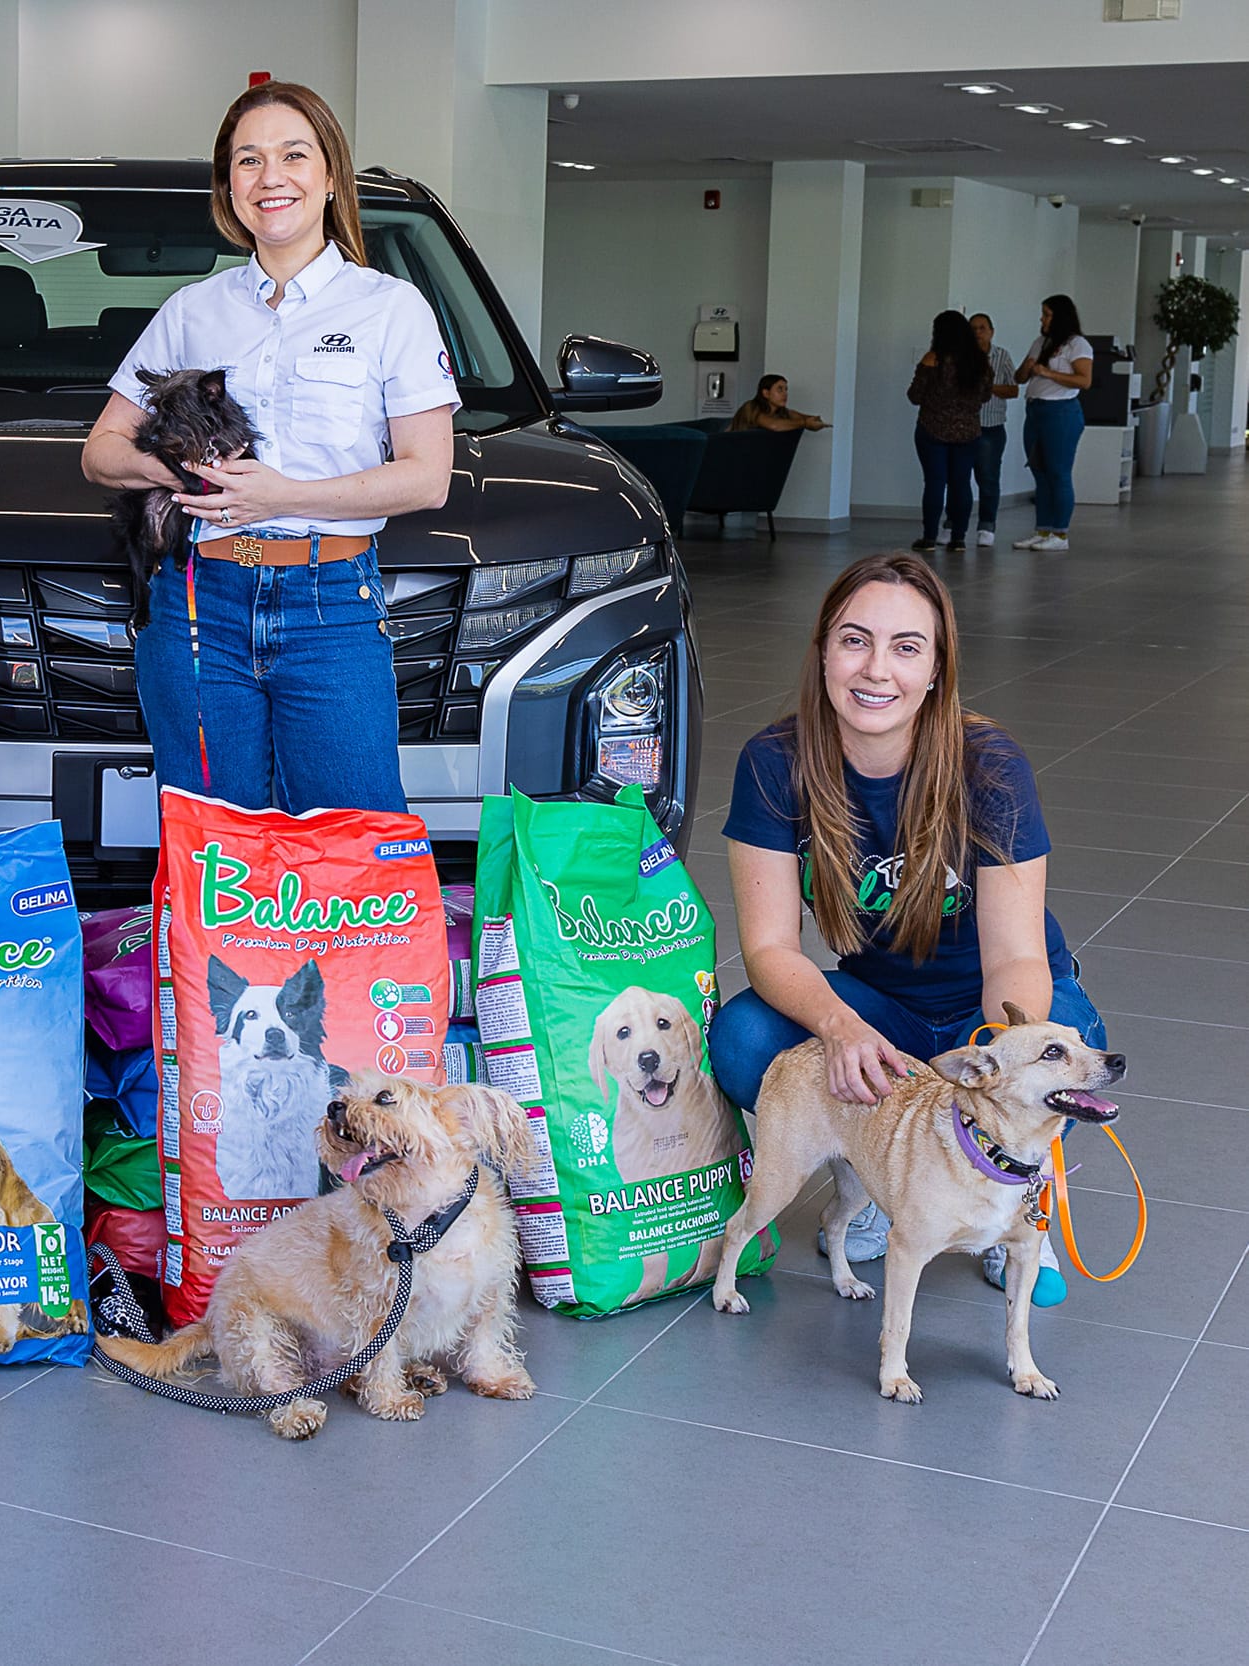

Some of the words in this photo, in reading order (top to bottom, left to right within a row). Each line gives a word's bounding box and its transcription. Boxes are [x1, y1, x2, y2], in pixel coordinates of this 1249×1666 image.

[380, 841, 428, 855] BELINA
[192, 841, 418, 933] Balance
[18, 889, 68, 911] BELINA
[221, 934, 291, 950] Premium
[295, 937, 327, 954] Dog
[332, 932, 410, 948] Nutrition
[622, 949, 645, 964] Dog
[646, 935, 705, 960] Nutrition
[578, 1154, 609, 1168] DHA
[589, 1178, 685, 1216] BALANCE
[689, 1162, 733, 1196] PUPPY
[202, 1207, 267, 1222] BALANCE
[629, 1223, 674, 1242] BALANCE
[675, 1210, 720, 1232] CACHORRO
[3, 1258, 24, 1267] Stage
[40, 1257, 62, 1268] NET
[40, 1267, 65, 1275] WEIGHT
